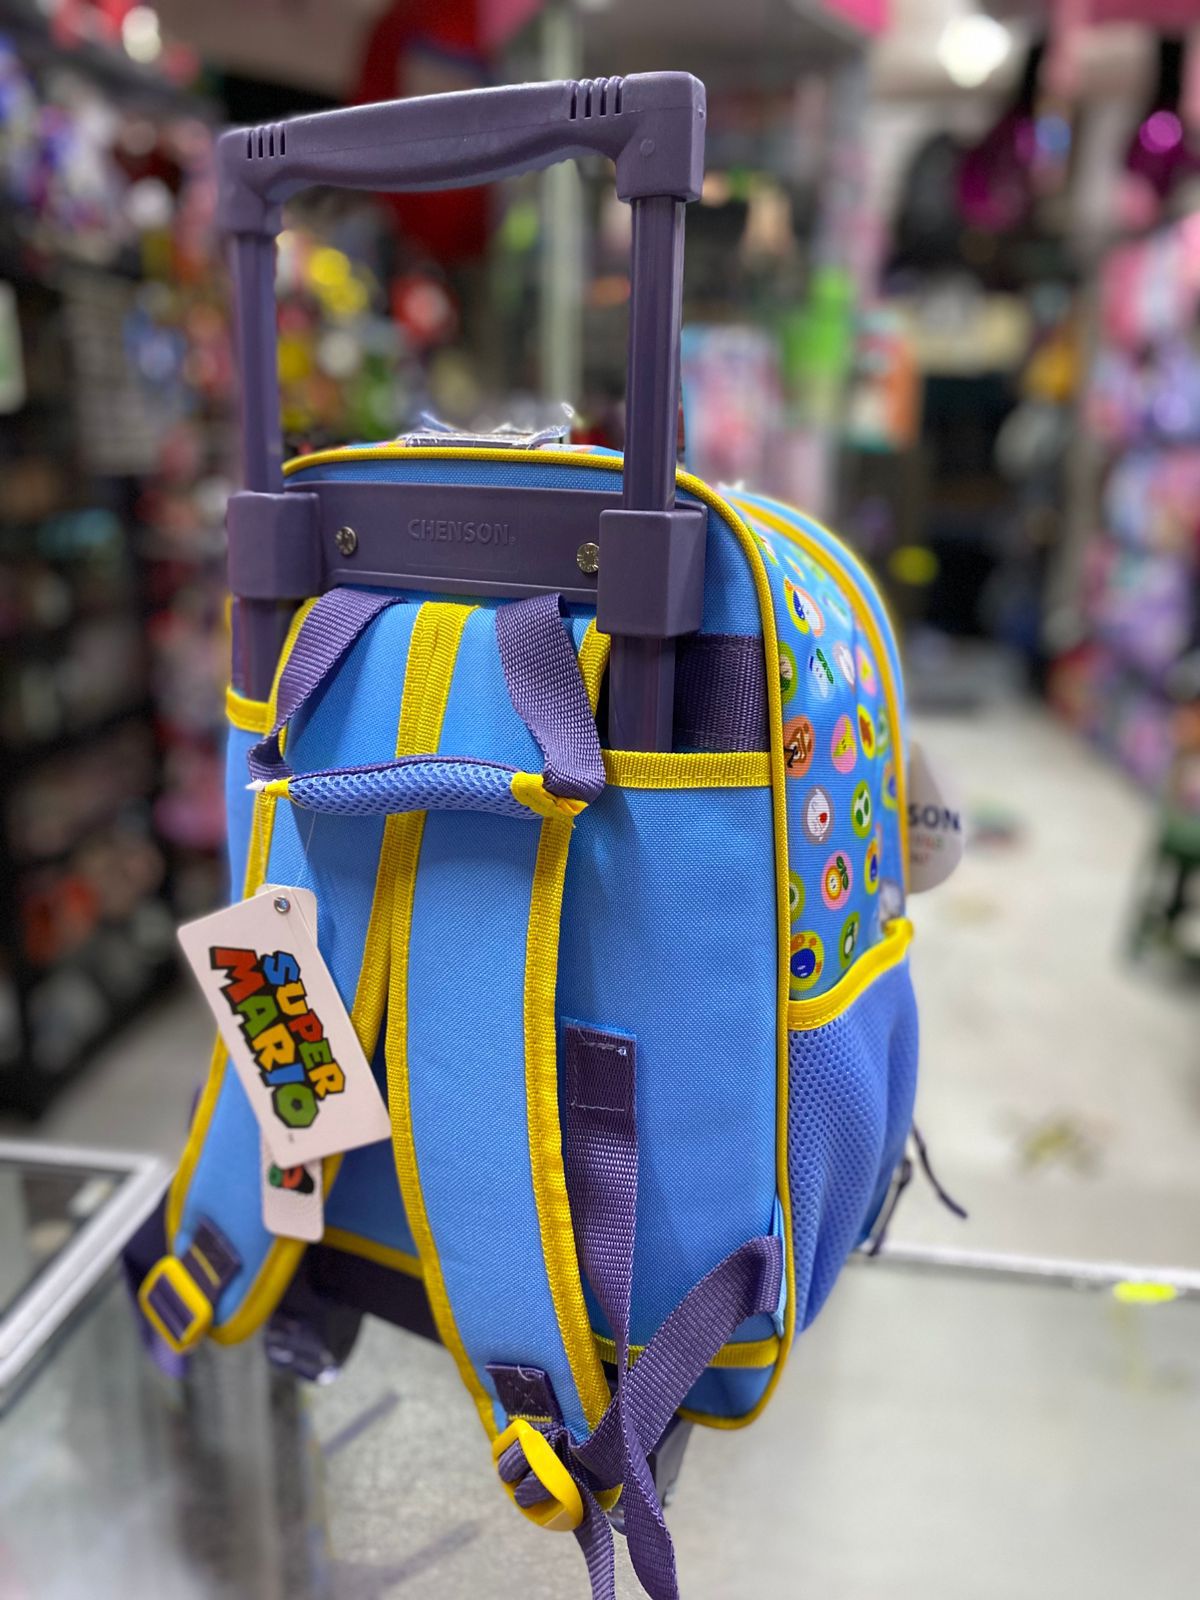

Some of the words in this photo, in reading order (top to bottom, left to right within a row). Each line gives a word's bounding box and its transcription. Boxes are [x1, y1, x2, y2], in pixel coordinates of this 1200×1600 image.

[407, 518, 510, 545] CHENSON
[209, 946, 320, 1129] MARIO
[261, 950, 346, 1100] SUPER
